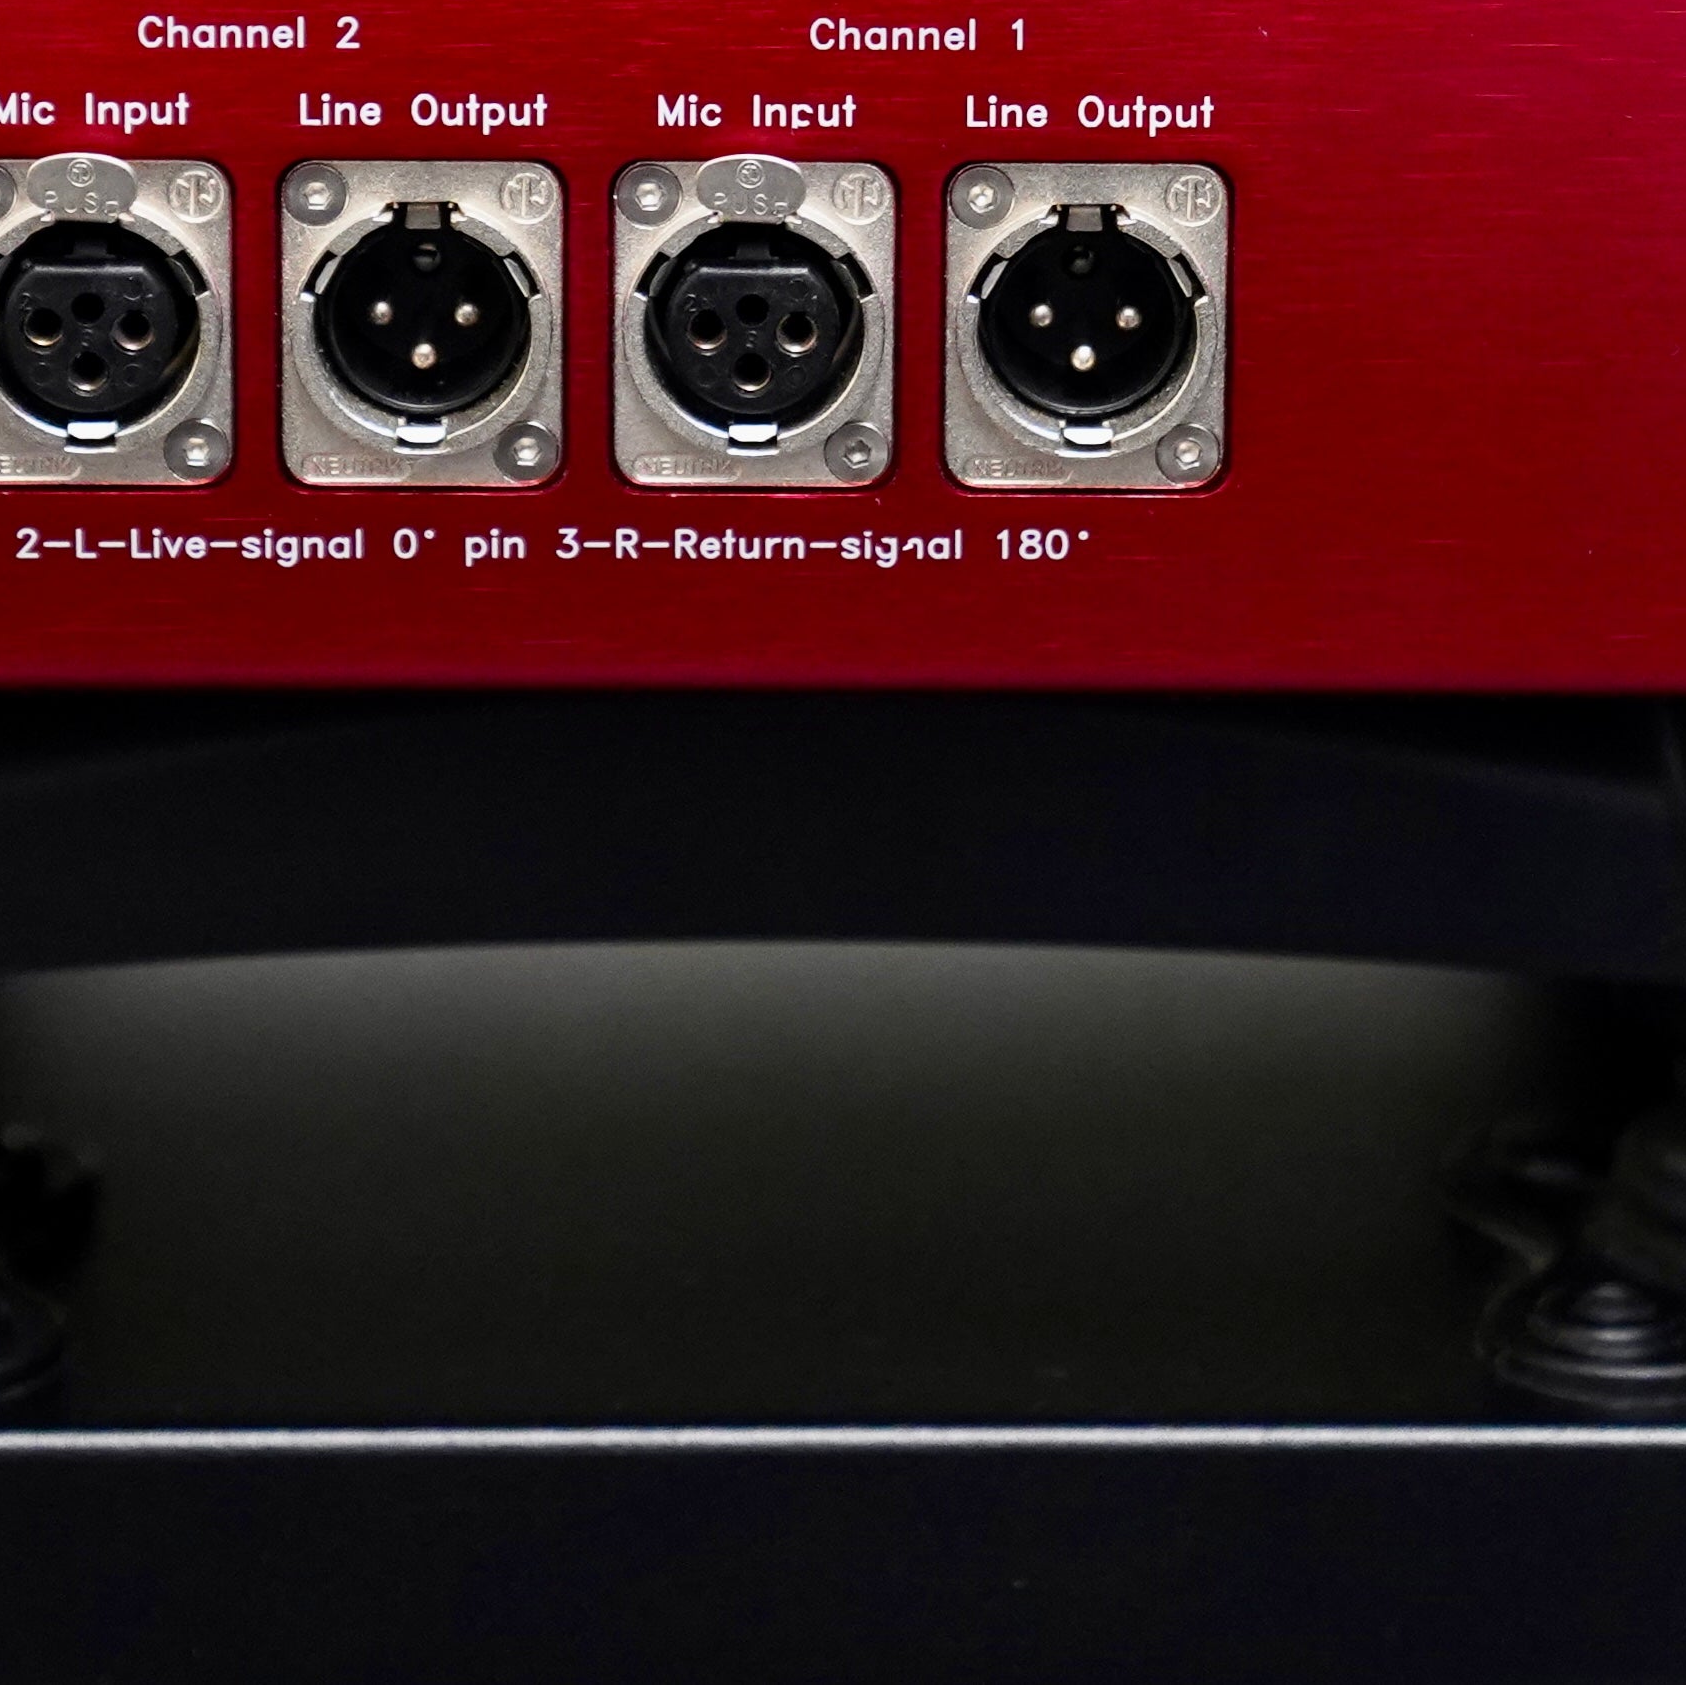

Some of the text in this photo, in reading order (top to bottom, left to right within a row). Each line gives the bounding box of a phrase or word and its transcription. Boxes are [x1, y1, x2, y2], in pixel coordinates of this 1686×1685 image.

[137, 15, 361, 49] Channel 2
[809, 17, 1024, 51] Channel 1
[85, 92, 190, 135] Input
[299, 92, 548, 136] Line Output
[657, 94, 722, 127] Mic
[966, 94, 1215, 137] Line Output
[15, 527, 363, 568] 2-L-Live-signal
[464, 528, 525, 568] pin
[996, 528, 1089, 560] 180°
